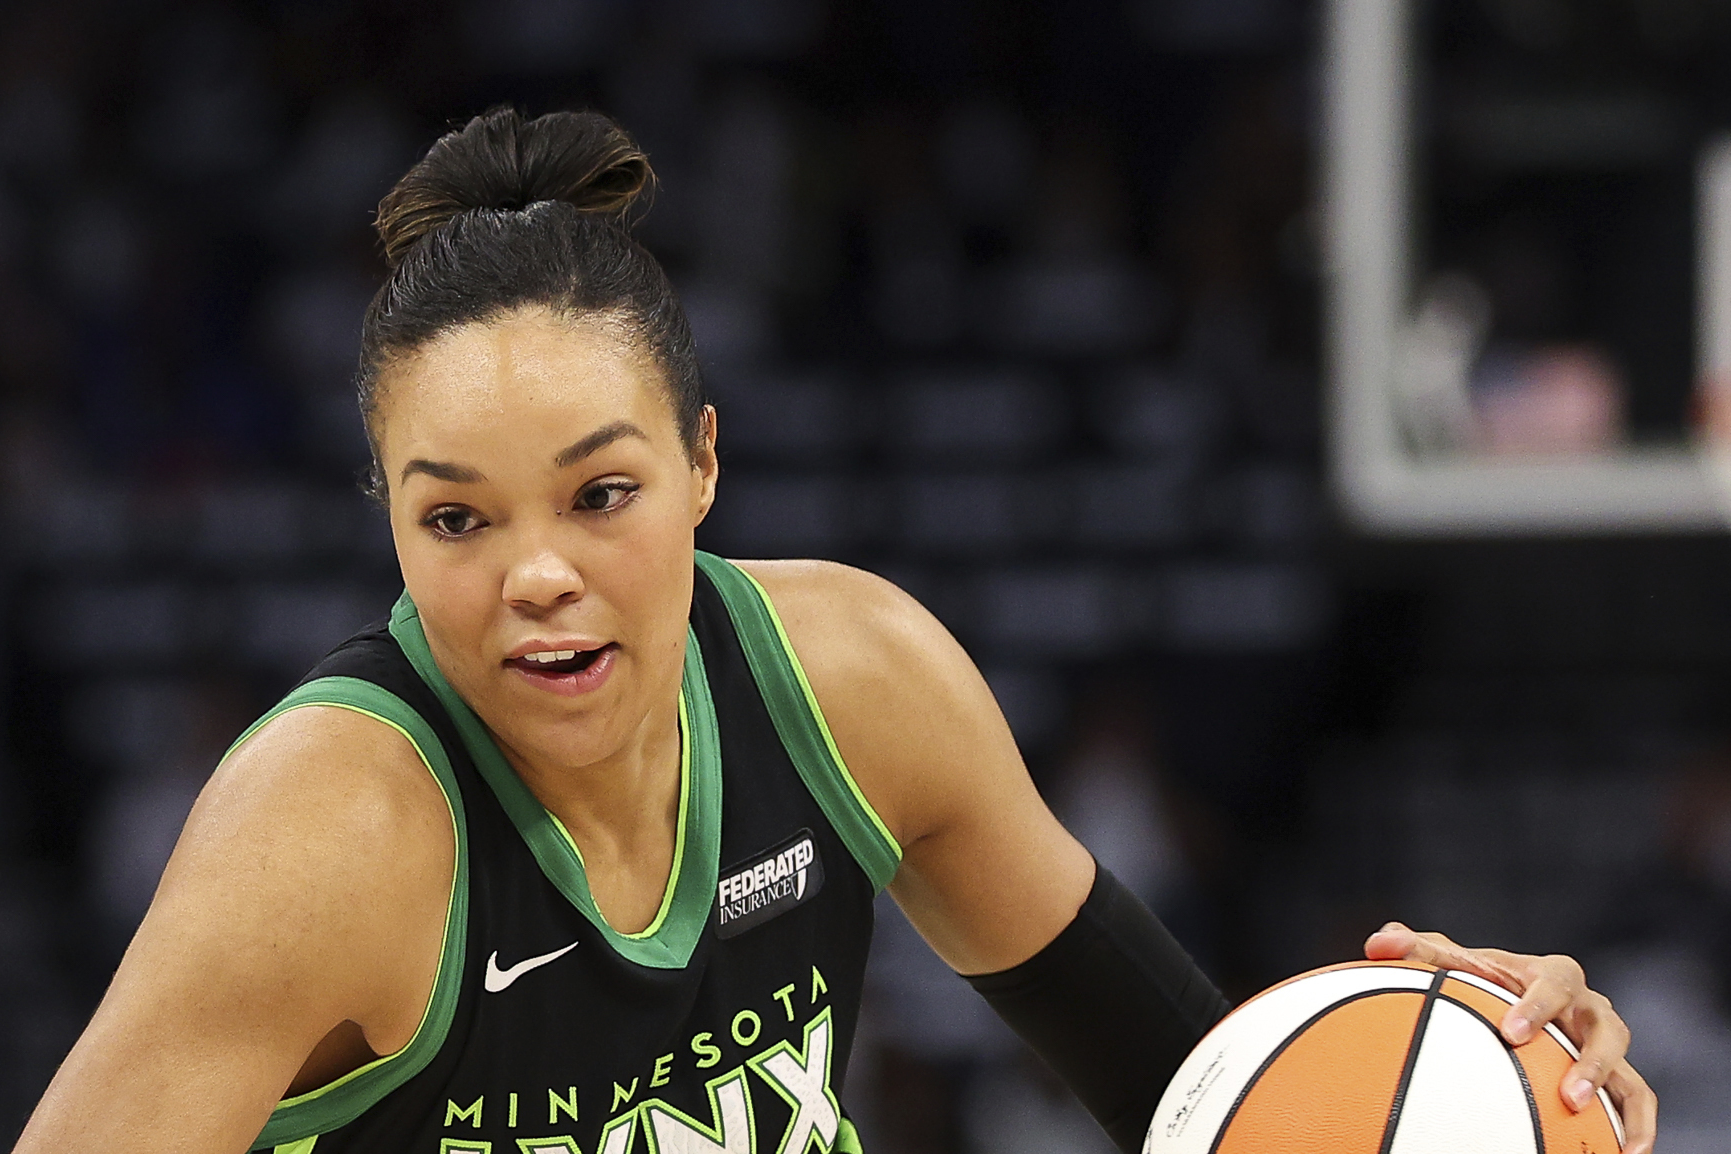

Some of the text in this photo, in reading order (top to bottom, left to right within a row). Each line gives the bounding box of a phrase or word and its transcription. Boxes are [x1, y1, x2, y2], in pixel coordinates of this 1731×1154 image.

[719, 838, 814, 907] FEDERATED
[720, 877, 792, 925] INSURANCE
[444, 965, 829, 1128] MINNESOTA
